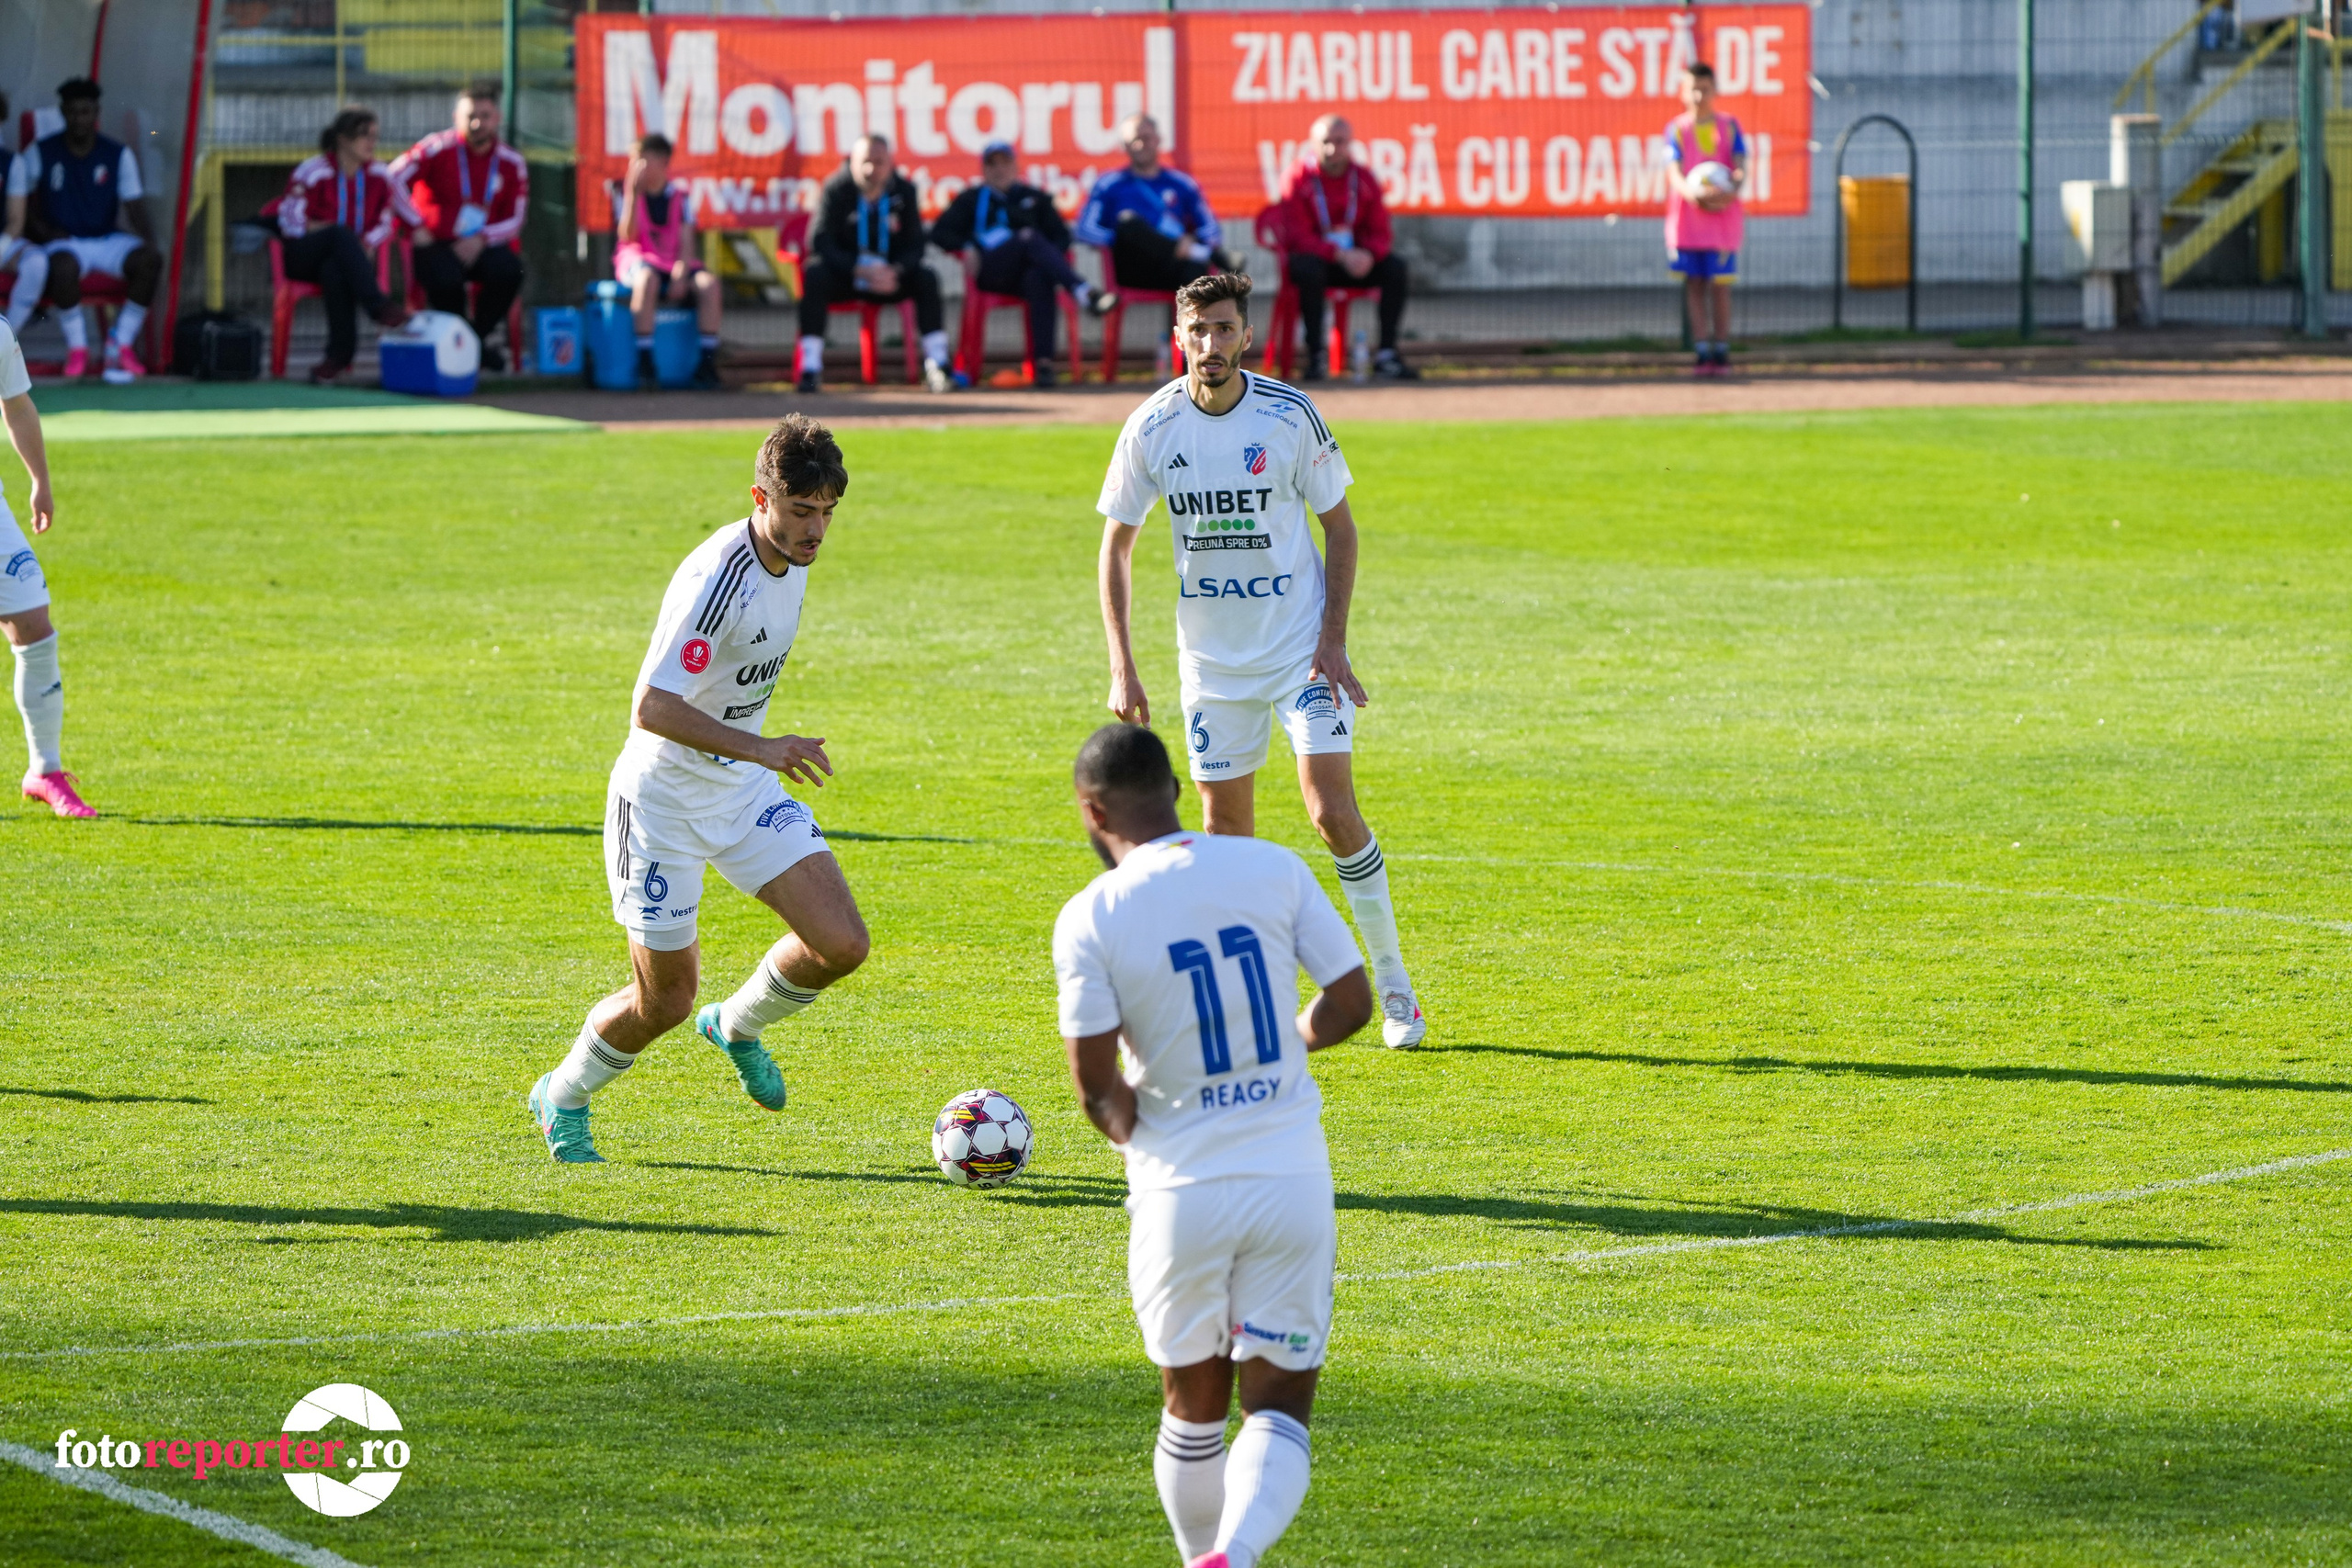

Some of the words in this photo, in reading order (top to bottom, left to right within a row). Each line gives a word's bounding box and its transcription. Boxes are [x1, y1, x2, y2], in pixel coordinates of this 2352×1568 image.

[1232, 30, 1429, 102] ZIARUL
[1440, 27, 1587, 101] CARE
[1597, 13, 1697, 100] STĂ
[1715, 26, 1784, 95] DE
[604, 27, 1176, 157] Monitorul
[1256, 122, 1446, 208] VBĂ
[1457, 136, 1531, 207] CU
[1169, 488, 1272, 516] UNIBET
[1226, 538, 1250, 548] SPRE
[1251, 536, 1268, 548] 0%
[1200, 761, 1231, 770] Vestra
[644, 862, 668, 903] 6
[1167, 925, 1281, 1076] 11
[1201, 1077, 1282, 1111] REAGY
